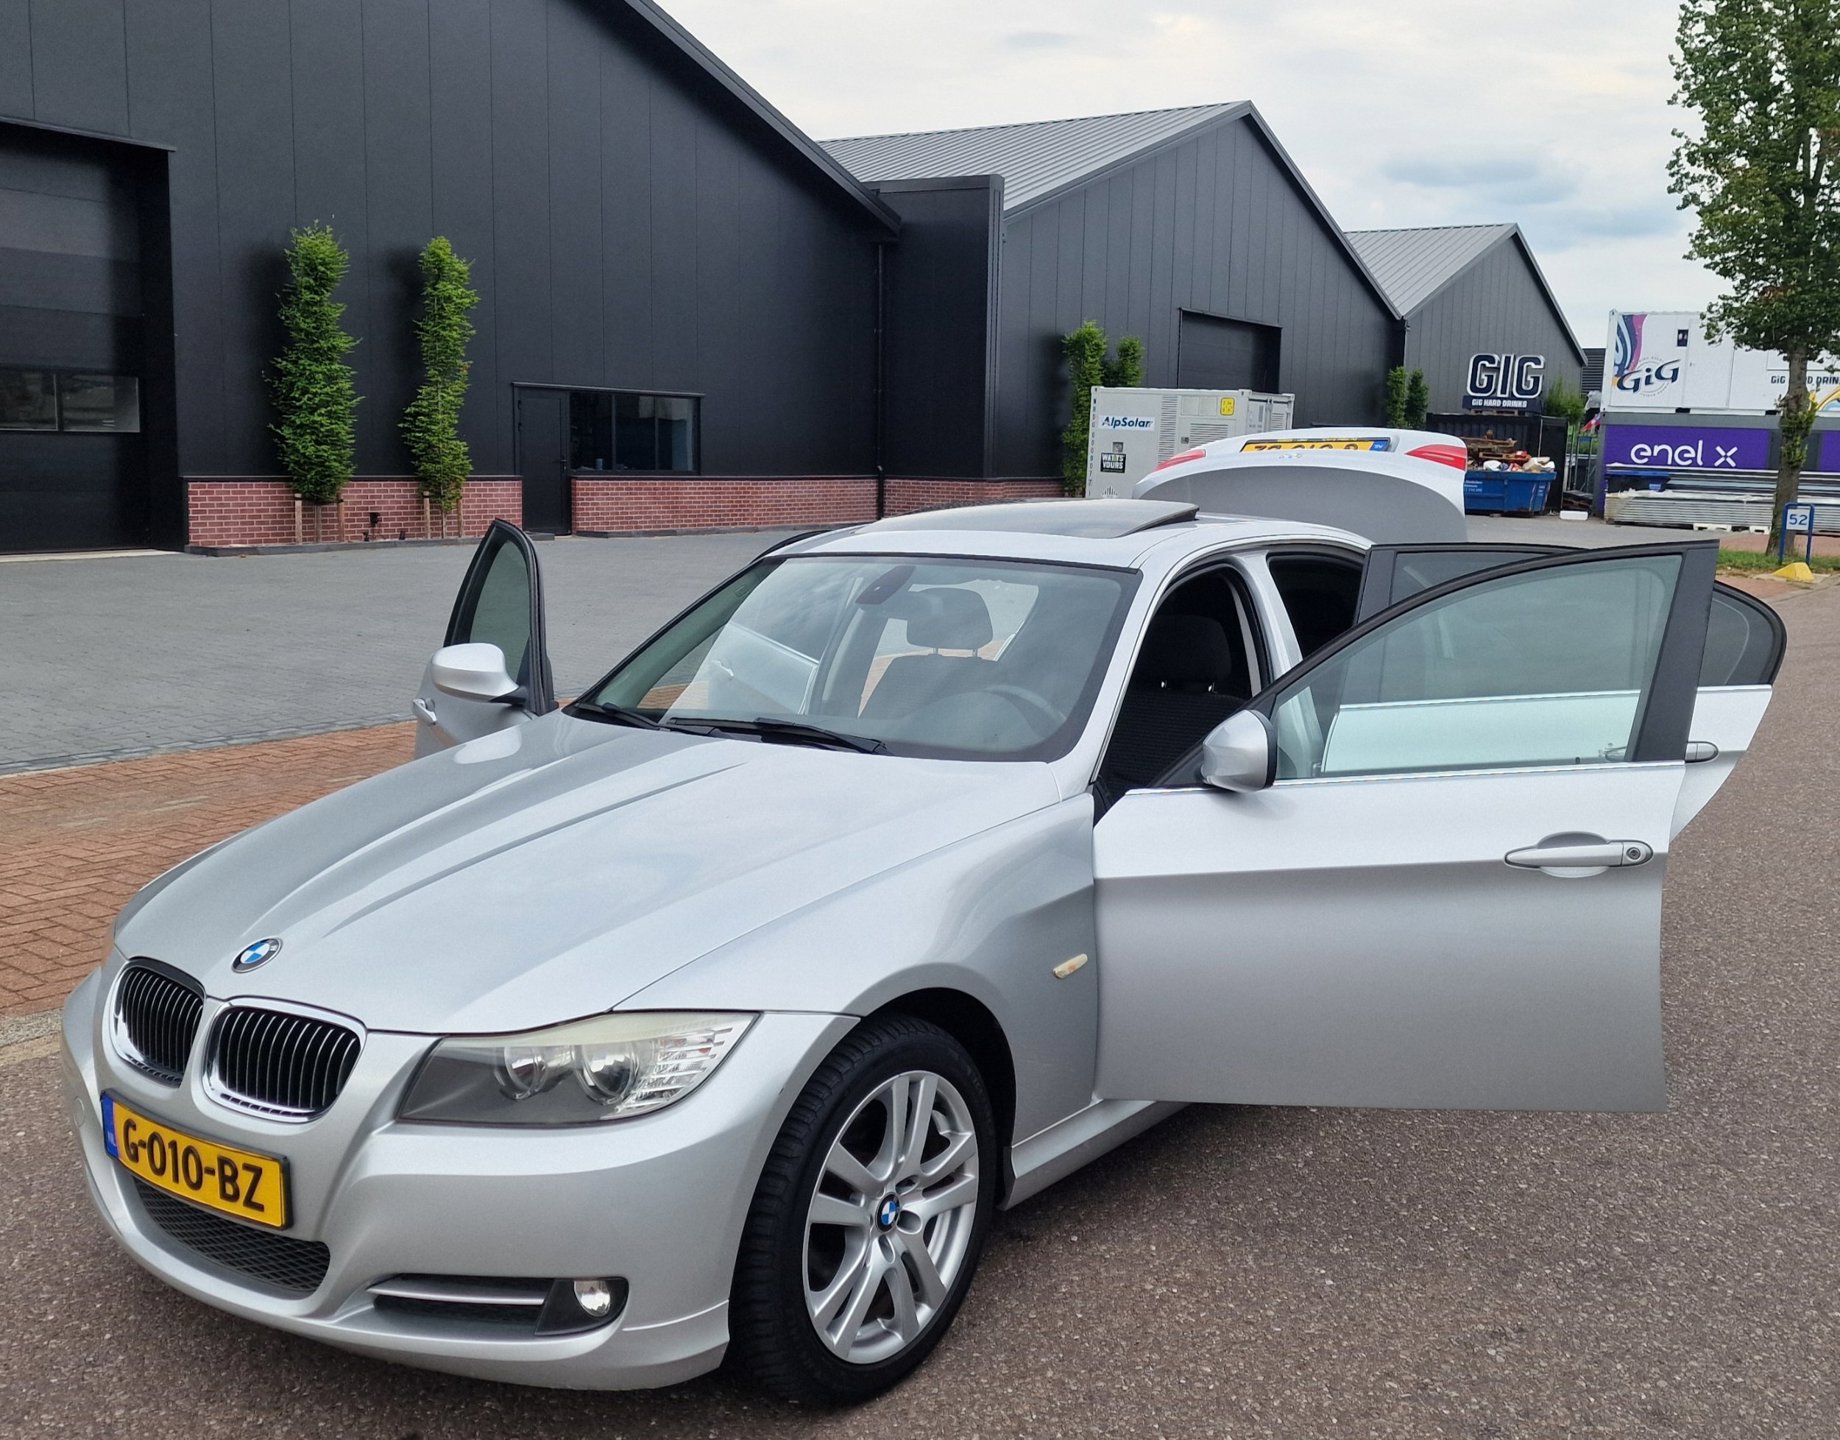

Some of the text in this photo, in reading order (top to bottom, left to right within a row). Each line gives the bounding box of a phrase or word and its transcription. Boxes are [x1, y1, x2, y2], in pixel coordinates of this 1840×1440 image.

[1467, 353, 1545, 398] GIG
[1816, 376, 1840, 385] DRIN
[1484, 399, 1501, 407] HARD
[1102, 416, 1151, 428] AlpSolar
[1630, 440, 1703, 466] enel
[1102, 461, 1124, 469] YOURS
[1789, 514, 1808, 526] 52
[123, 1118, 265, 1213] G-010-BZ
